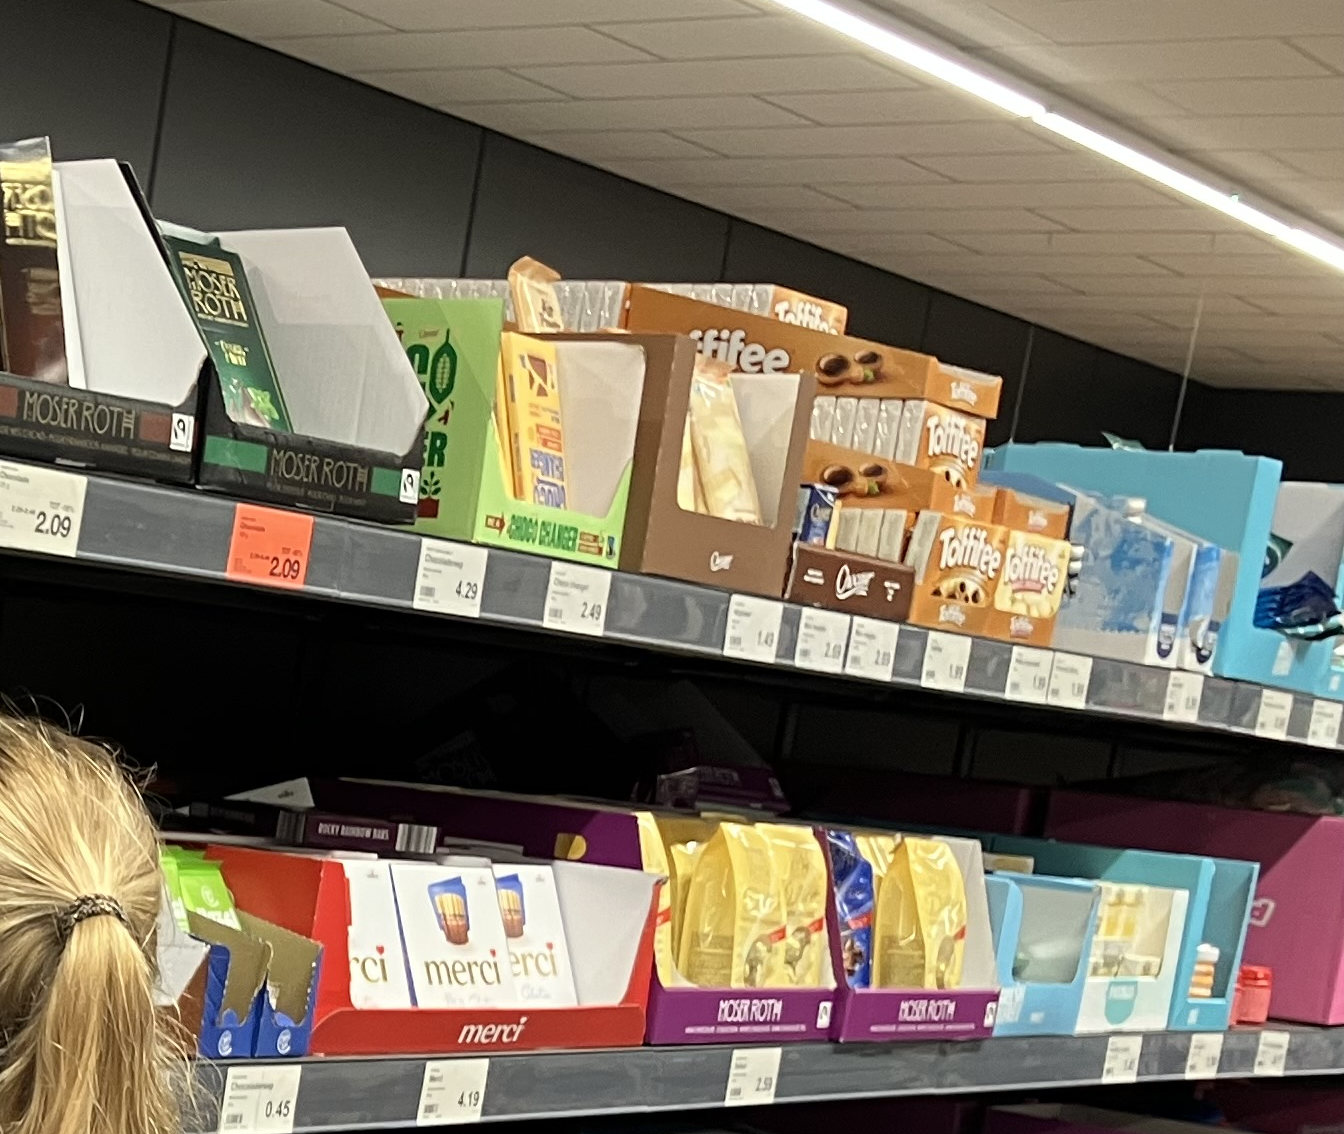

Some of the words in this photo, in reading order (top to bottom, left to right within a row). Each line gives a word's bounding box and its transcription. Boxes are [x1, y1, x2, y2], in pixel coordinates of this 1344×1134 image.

[183, 266, 241, 300] MOSER
[190, 291, 248, 322] ROTH
[23, 390, 77, 429] MOSER
[81, 402, 136, 440] ROTH
[269, 448, 320, 482] MOSER
[321, 457, 369, 494] ROTH
[34, 510, 72, 538] 2.09
[269, 556, 301, 580] 2.09
[939, 525, 1002, 580] Toffifee
[350, 945, 389, 988] rci
[424, 948, 502, 987] merci
[510, 942, 558, 978] erci
[457, 1016, 528, 1044] merci
[265, 1100, 291, 1119] 0.45
[457, 1090, 480, 1108] 4.19
